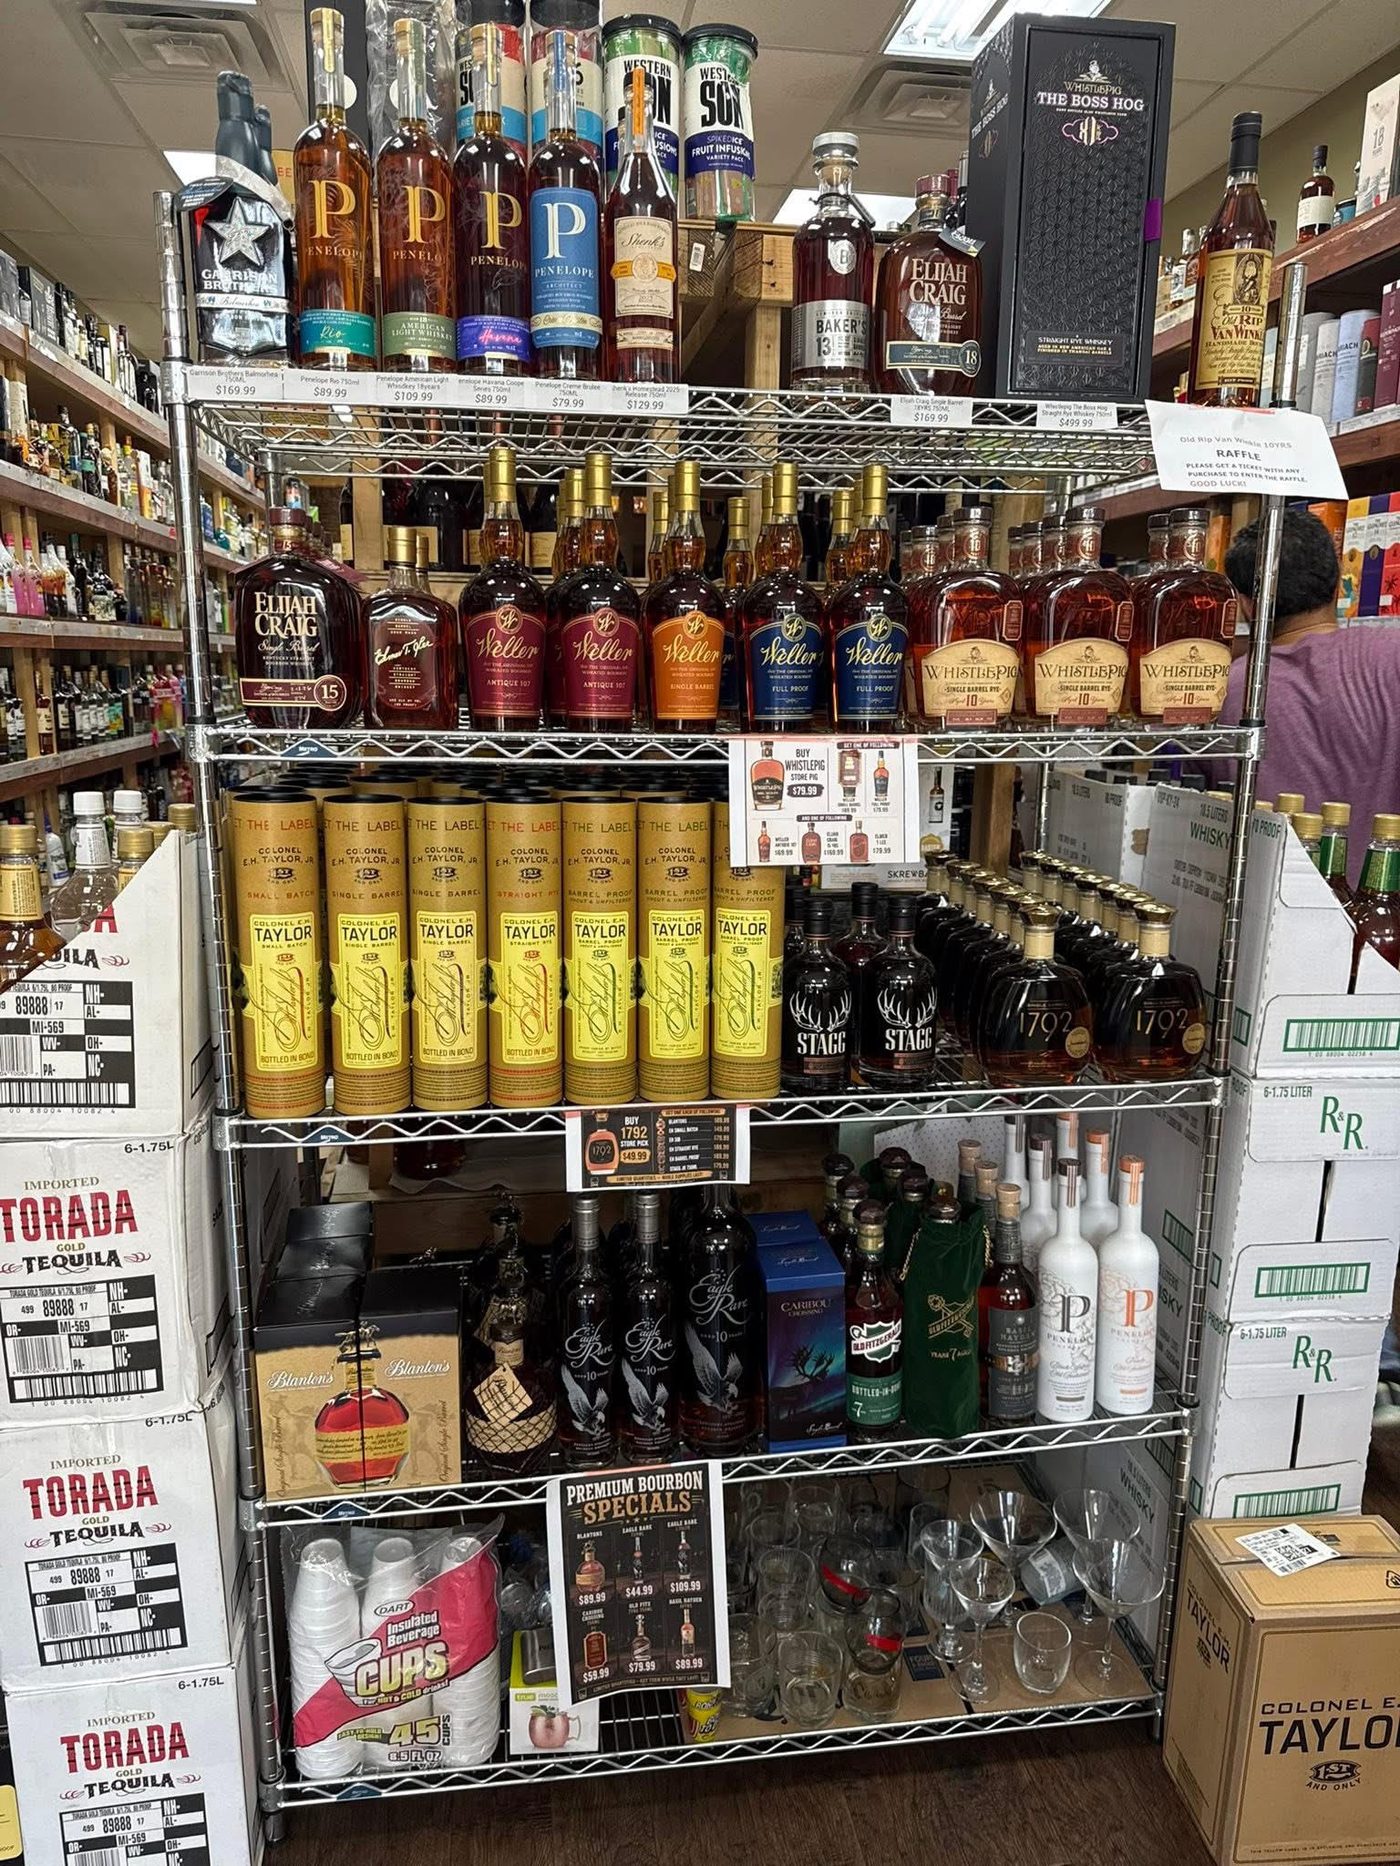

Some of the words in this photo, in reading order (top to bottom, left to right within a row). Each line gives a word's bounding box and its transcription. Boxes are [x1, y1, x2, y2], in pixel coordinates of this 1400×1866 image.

[1036, 92, 1068, 106] THE
[1071, 94, 1109, 109] BOSS
[1112, 97, 1145, 111] HOG
[308, 180, 356, 239] P
[541, 203, 586, 260] P
[620, 231, 666, 249] Shenk's
[534, 264, 595, 280] PENELOPE
[911, 258, 969, 283] ELIJAH
[908, 280, 967, 306] CRAIG
[401, 323, 446, 332] AMERICAN
[816, 318, 868, 335] BAKER'S
[1240, 315, 1263, 326] RIP
[478, 328, 523, 345] Havana
[1211, 325, 1233, 340] VAN
[816, 337, 832, 357] 13
[965, 349, 978, 365] 18
[300, 376, 328, 384] Penelope
[215, 385, 256, 395] $169.99
[313, 387, 348, 398] $89.99
[394, 391, 433, 402] $109.99
[475, 394, 508, 405] $89.99
[552, 398, 585, 408] $79.99
[626, 399, 664, 410] $129.99
[914, 413, 949, 423] $169.99
[1059, 418, 1093, 428] $499.99
[1216, 449, 1262, 461] RAFFLE
[1239, 463, 1263, 471] TICKET
[1190, 480, 1218, 488] GOOD
[254, 591, 318, 616] ELIJAH
[254, 613, 318, 640] CRAIG
[476, 628, 539, 659] Weller
[573, 629, 633, 662] Weller
[663, 631, 721, 664] Weller
[760, 636, 817, 666] Weller
[845, 636, 904, 666] Weller
[925, 664, 1018, 680] WHISTLEPIG
[486, 679, 518, 688] ANTIQUE
[519, 680, 532, 688] 107
[670, 682, 694, 690] SINGLE
[790, 685, 809, 693] PROOF
[320, 684, 339, 700] 15
[966, 694, 978, 707] 10
[795, 748, 811, 758] BUY
[785, 759, 826, 772] WHISTLEPIG
[791, 773, 807, 781] STORE
[809, 773, 818, 781] PIG
[792, 786, 818, 796] $79.99
[247, 819, 270, 831] THE
[280, 818, 315, 831] LABEL
[335, 820, 360, 832] THE
[367, 820, 401, 832] LABEL
[1190, 821, 1232, 849] WHISKY
[258, 847, 302, 855] COLONEL
[747, 888, 776, 896] PROOF
[254, 925, 313, 942] TAYLOR
[341, 925, 397, 942] TAYLOR
[420, 924, 474, 939] TAYLOR
[505, 925, 556, 940] TAYLOR
[575, 924, 626, 939] TAYLOR
[652, 922, 702, 937] TAYLOR
[717, 920, 767, 936] TAYLOR
[15, 995, 49, 1015] 89888
[54, 1001, 64, 1011] 17
[1019, 1011, 1073, 1041] 1792
[1137, 1008, 1189, 1039] 1792
[797, 1031, 846, 1056] STAGG
[885, 1027, 932, 1051] STAGG
[260, 1054, 289, 1064] BOTTLED
[289, 1054, 298, 1063] IN
[1263, 1086, 1290, 1098] 6-1.75
[1291, 1085, 1313, 1097] LITER
[625, 1116, 639, 1126] BUY
[621, 1126, 648, 1139] 1792
[124, 1141, 175, 1154] 6-1.75L
[620, 1139, 636, 1148] STORE
[636, 1139, 649, 1147] PICK
[622, 1151, 647, 1161] $49.99
[24, 1176, 100, 1191] IMPORTED
[0, 1189, 138, 1243] TORADA
[56, 1242, 86, 1252] GOLD
[22, 1250, 123, 1275] TEQUILA
[42, 1298, 75, 1318] 89888
[780, 1299, 831, 1313] CARIBOU
[1124, 1289, 1154, 1328] P
[1059, 1294, 1091, 1334] P
[59, 1320, 90, 1333] MI-569
[1240, 1327, 1265, 1339] 6-1.75
[1266, 1326, 1288, 1338] LITER
[715, 1330, 728, 1343] 10
[384, 1358, 452, 1378] Blanton's
[586, 1370, 598, 1381] 10
[267, 1369, 335, 1390] Blanton's
[50, 1454, 122, 1470] IMPORTED
[22, 1465, 159, 1520] TORADA
[566, 1478, 634, 1506] PREMIUM
[638, 1471, 703, 1493] BOURBON
[583, 1491, 692, 1525] SPECIALS
[82, 1515, 110, 1525] GOLD
[49, 1521, 145, 1548] TEQUILA
[70, 1566, 101, 1586] 89888
[625, 1585, 654, 1598] $44.99
[670, 1580, 701, 1593] $109.99
[578, 1592, 606, 1605] $89.99
[379, 1601, 411, 1615] DART
[387, 1611, 438, 1636] Insulated
[1186, 1587, 1231, 1674] TAYLOR
[387, 1624, 441, 1649] Beverage
[355, 1640, 448, 1698] CUPS
[629, 1660, 656, 1673] $79.99
[675, 1658, 703, 1670] $89.99
[582, 1667, 610, 1683] $59.99
[178, 1675, 225, 1691] 6-1.75L
[1261, 1699, 1373, 1715] COLONEL
[87, 1711, 156, 1728] IMPORTED
[388, 1716, 441, 1747] 45
[441, 1714, 451, 1746] CUPS
[60, 1721, 190, 1774] TORADA
[388, 1751, 410, 1762] 8.5
[411, 1750, 424, 1762] FL
[426, 1750, 442, 1762] OZ
[115, 1768, 143, 1778] GOLD
[84, 1773, 176, 1799] TEQUILA
[1306, 1780, 1327, 1791] AND
[1333, 1777, 1362, 1791] ONLY
